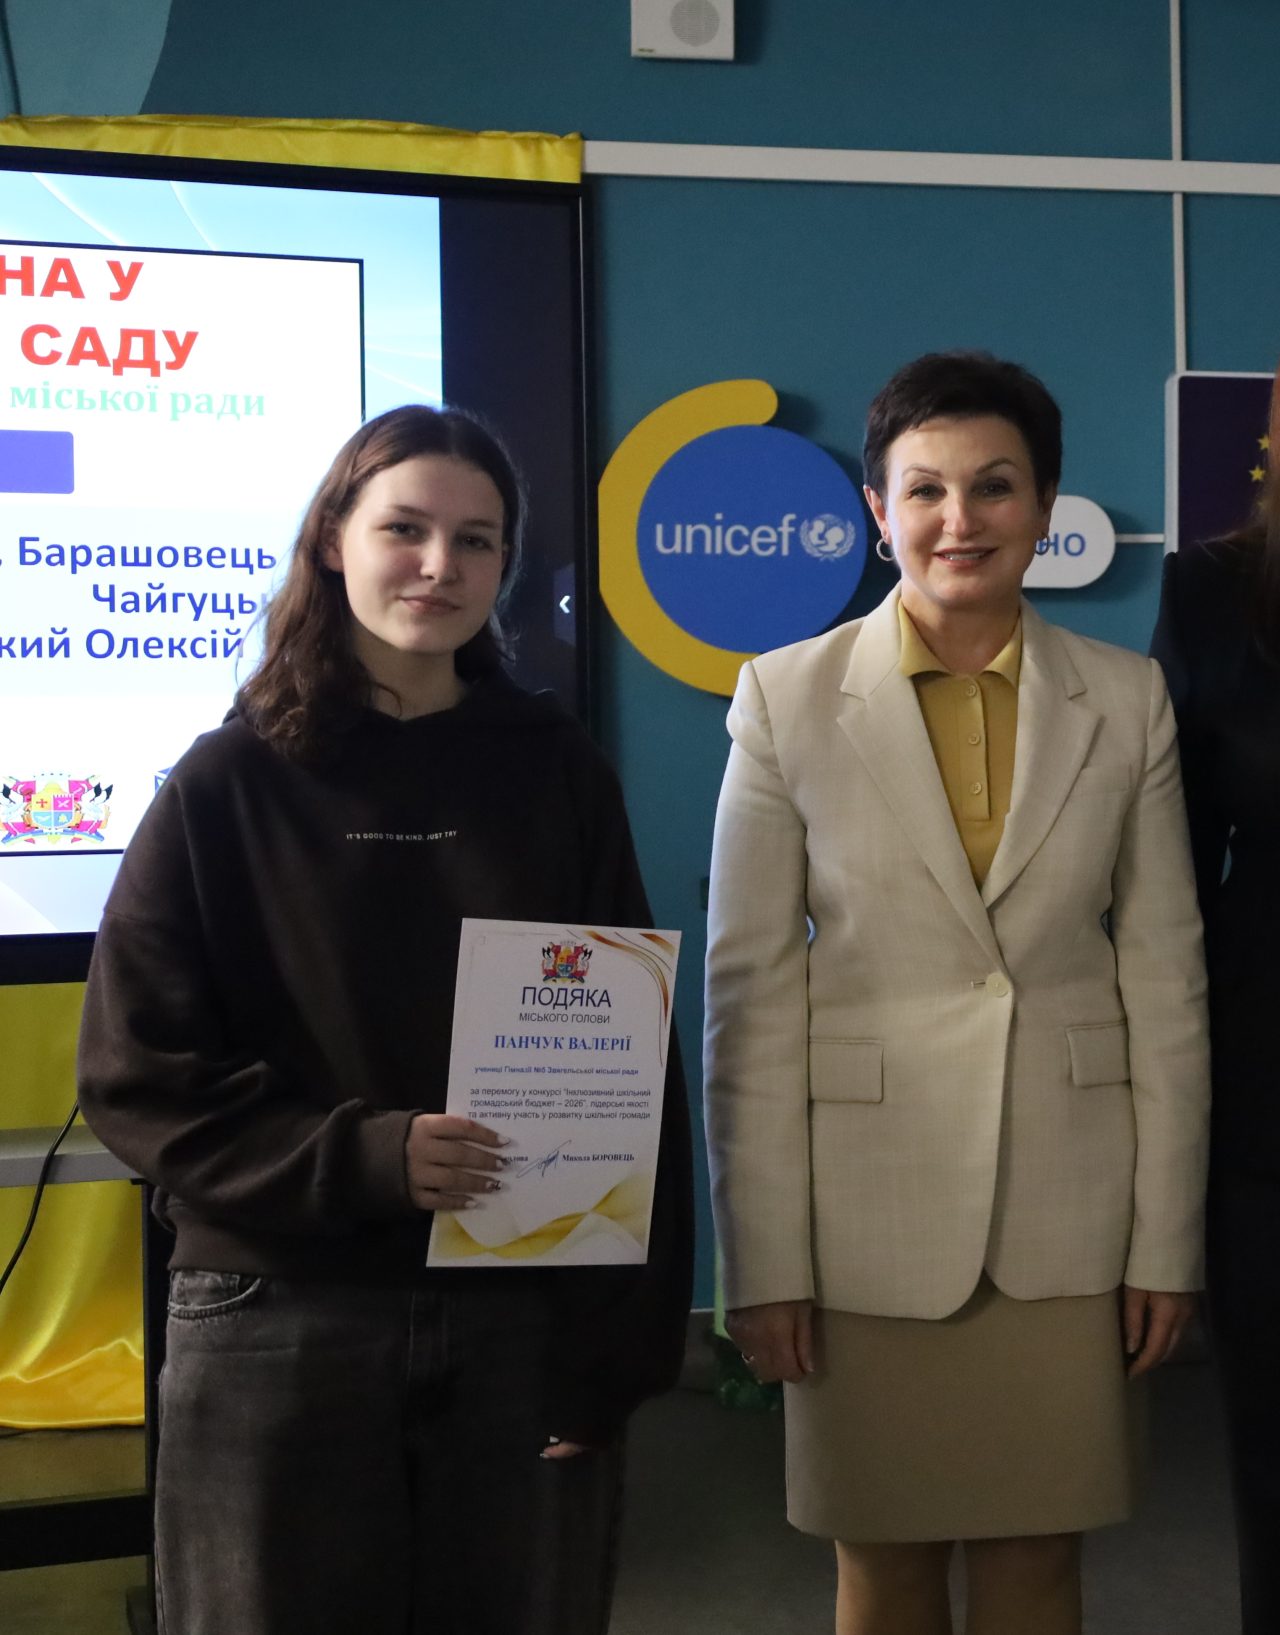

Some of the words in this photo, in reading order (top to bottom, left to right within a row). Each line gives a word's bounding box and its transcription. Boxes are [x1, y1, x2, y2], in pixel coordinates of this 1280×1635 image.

[106, 260, 144, 301] У
[20, 324, 199, 378] САДУ
[9, 381, 159, 413] міської
[169, 392, 265, 421] ради
[655, 513, 796, 556] unicef
[18, 536, 277, 575] Барашовець
[92, 583, 268, 621] Чайгуць
[85, 628, 244, 659] Олексій
[521, 986, 612, 1010] ПОДЯКА
[519, 1012, 569, 1022] МІСЬКОГО
[571, 1014, 610, 1024] ГОЛОВИ
[494, 1035, 564, 1049] ПАНЧУК
[568, 1036, 632, 1051] ВАЛЕРІЇ
[482, 1088, 520, 1097] перемогу
[522, 1089, 527, 1097] у
[529, 1088, 562, 1097] конкурсі
[479, 1112, 511, 1120] активну
[513, 1112, 540, 1120] участь
[549, 1112, 583, 1120] розвитку
